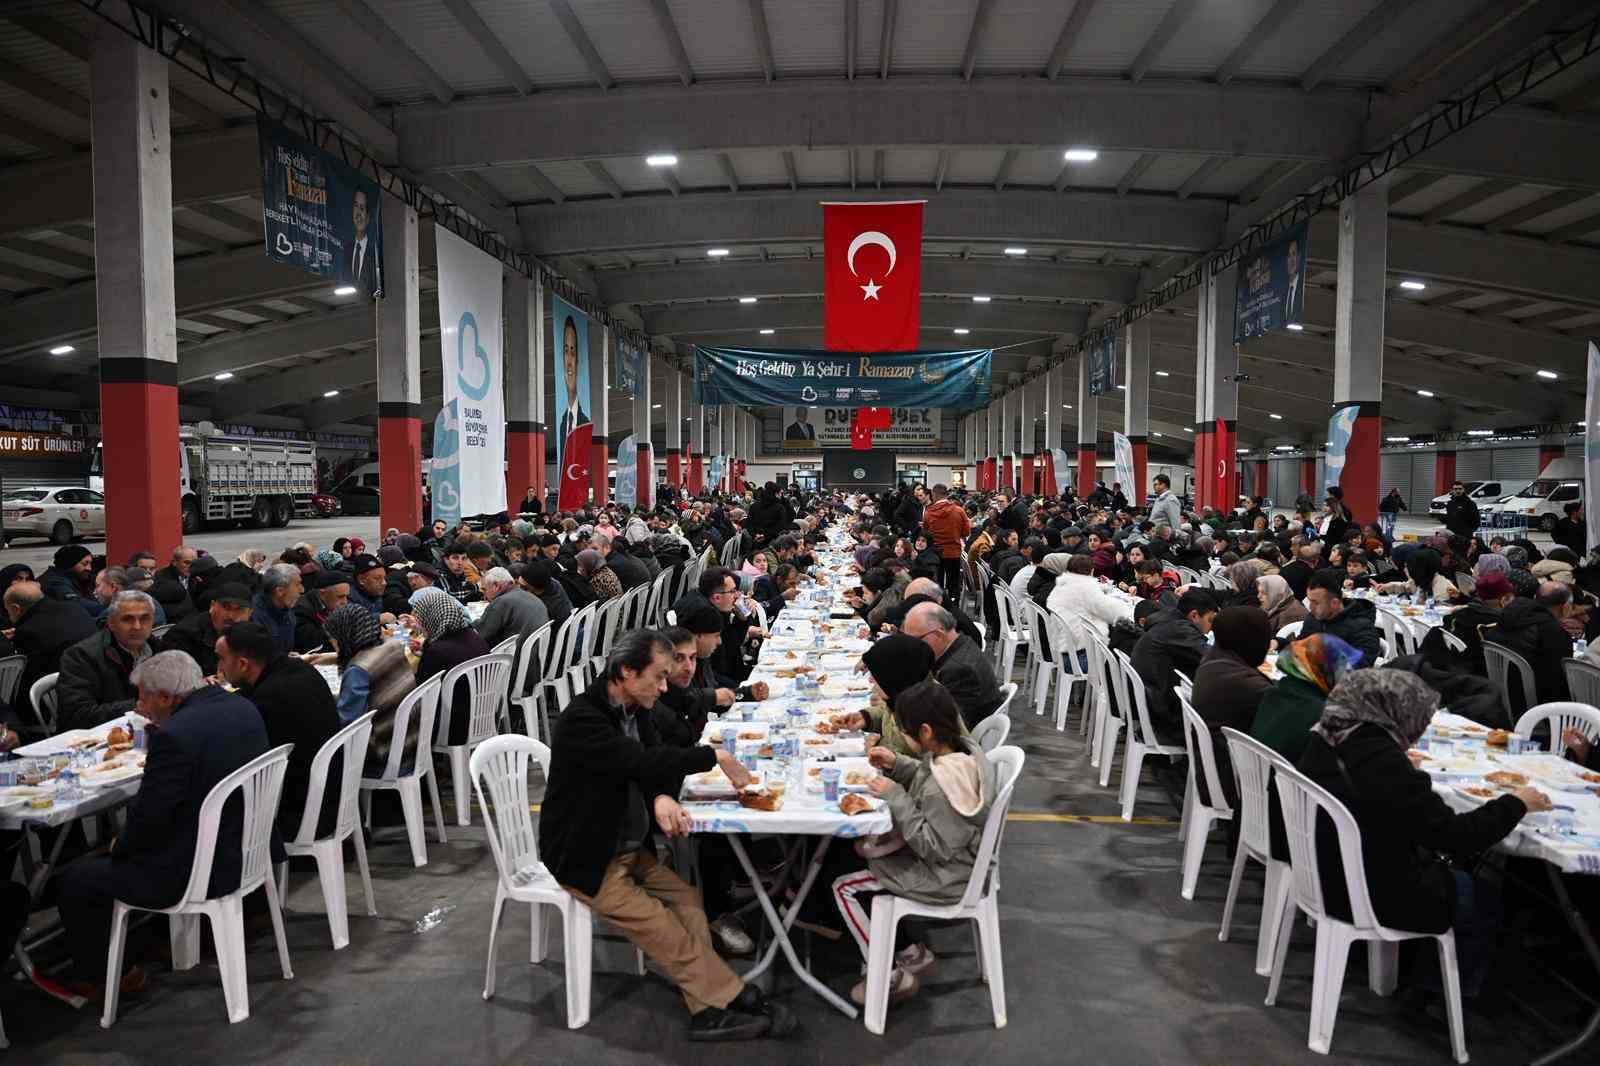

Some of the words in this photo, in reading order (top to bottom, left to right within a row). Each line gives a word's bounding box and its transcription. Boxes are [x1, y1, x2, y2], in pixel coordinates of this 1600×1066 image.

[736, 359, 757, 378] Hoş
[759, 359, 795, 378] Geldin
[801, 361, 815, 376] Ya
[816, 361, 850, 379] Şehr-i
[859, 356, 914, 379] Ramazan
[21, 435, 40, 451] SÜT
